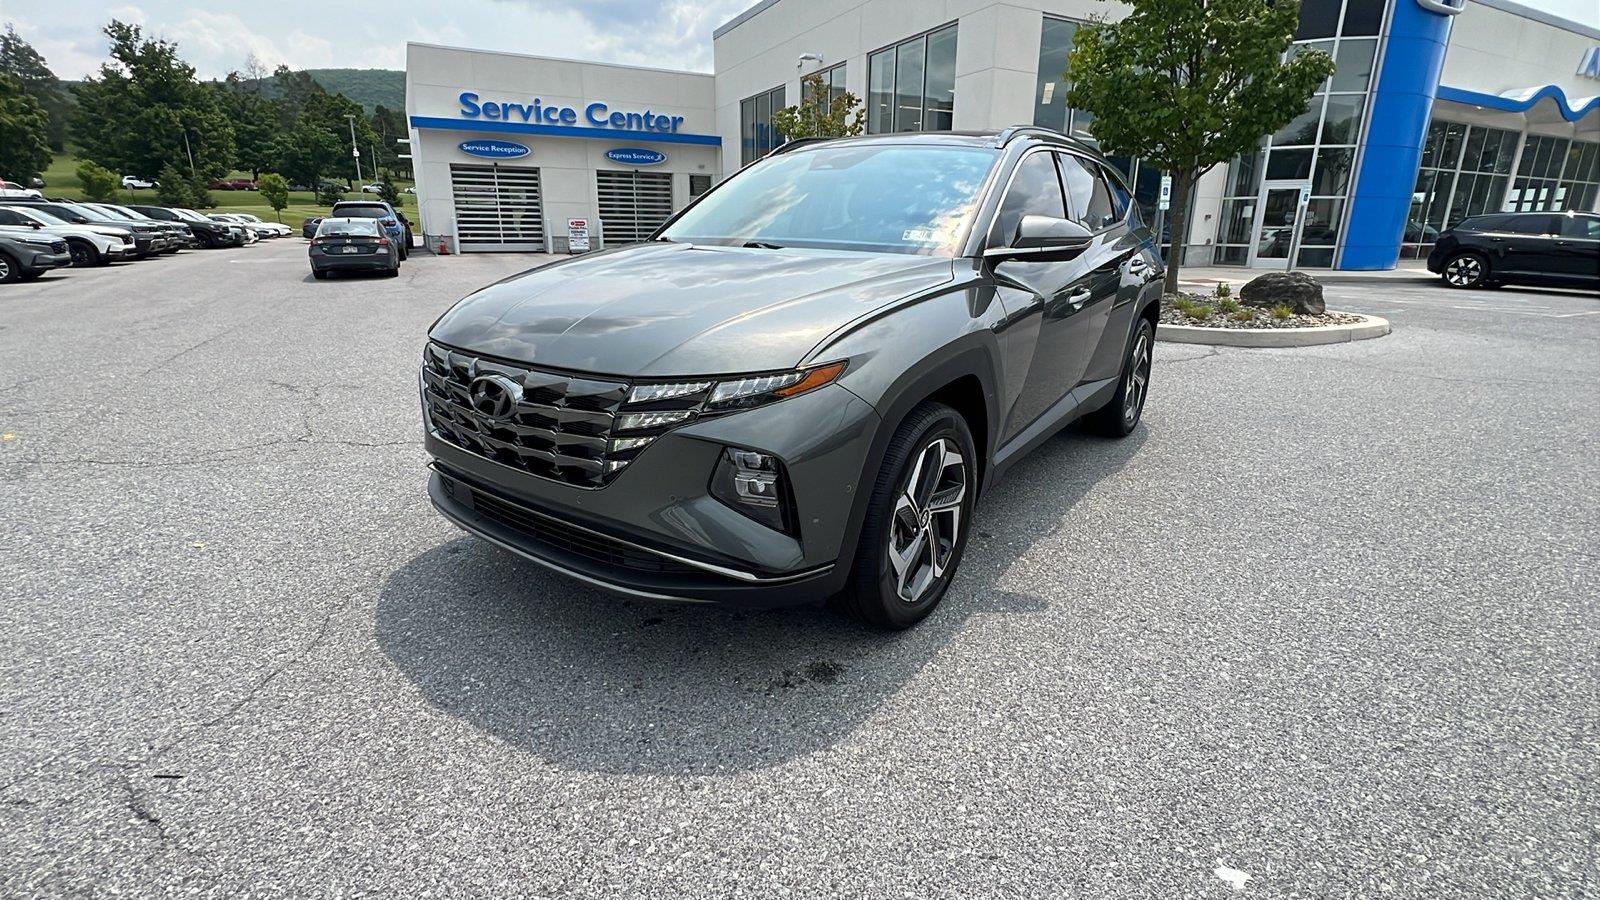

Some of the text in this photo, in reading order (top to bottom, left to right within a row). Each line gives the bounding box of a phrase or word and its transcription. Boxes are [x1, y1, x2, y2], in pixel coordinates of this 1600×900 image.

[459, 92, 684, 133] Service Center
[462, 143, 526, 154] Service Reception
[608, 151, 632, 160] Express
